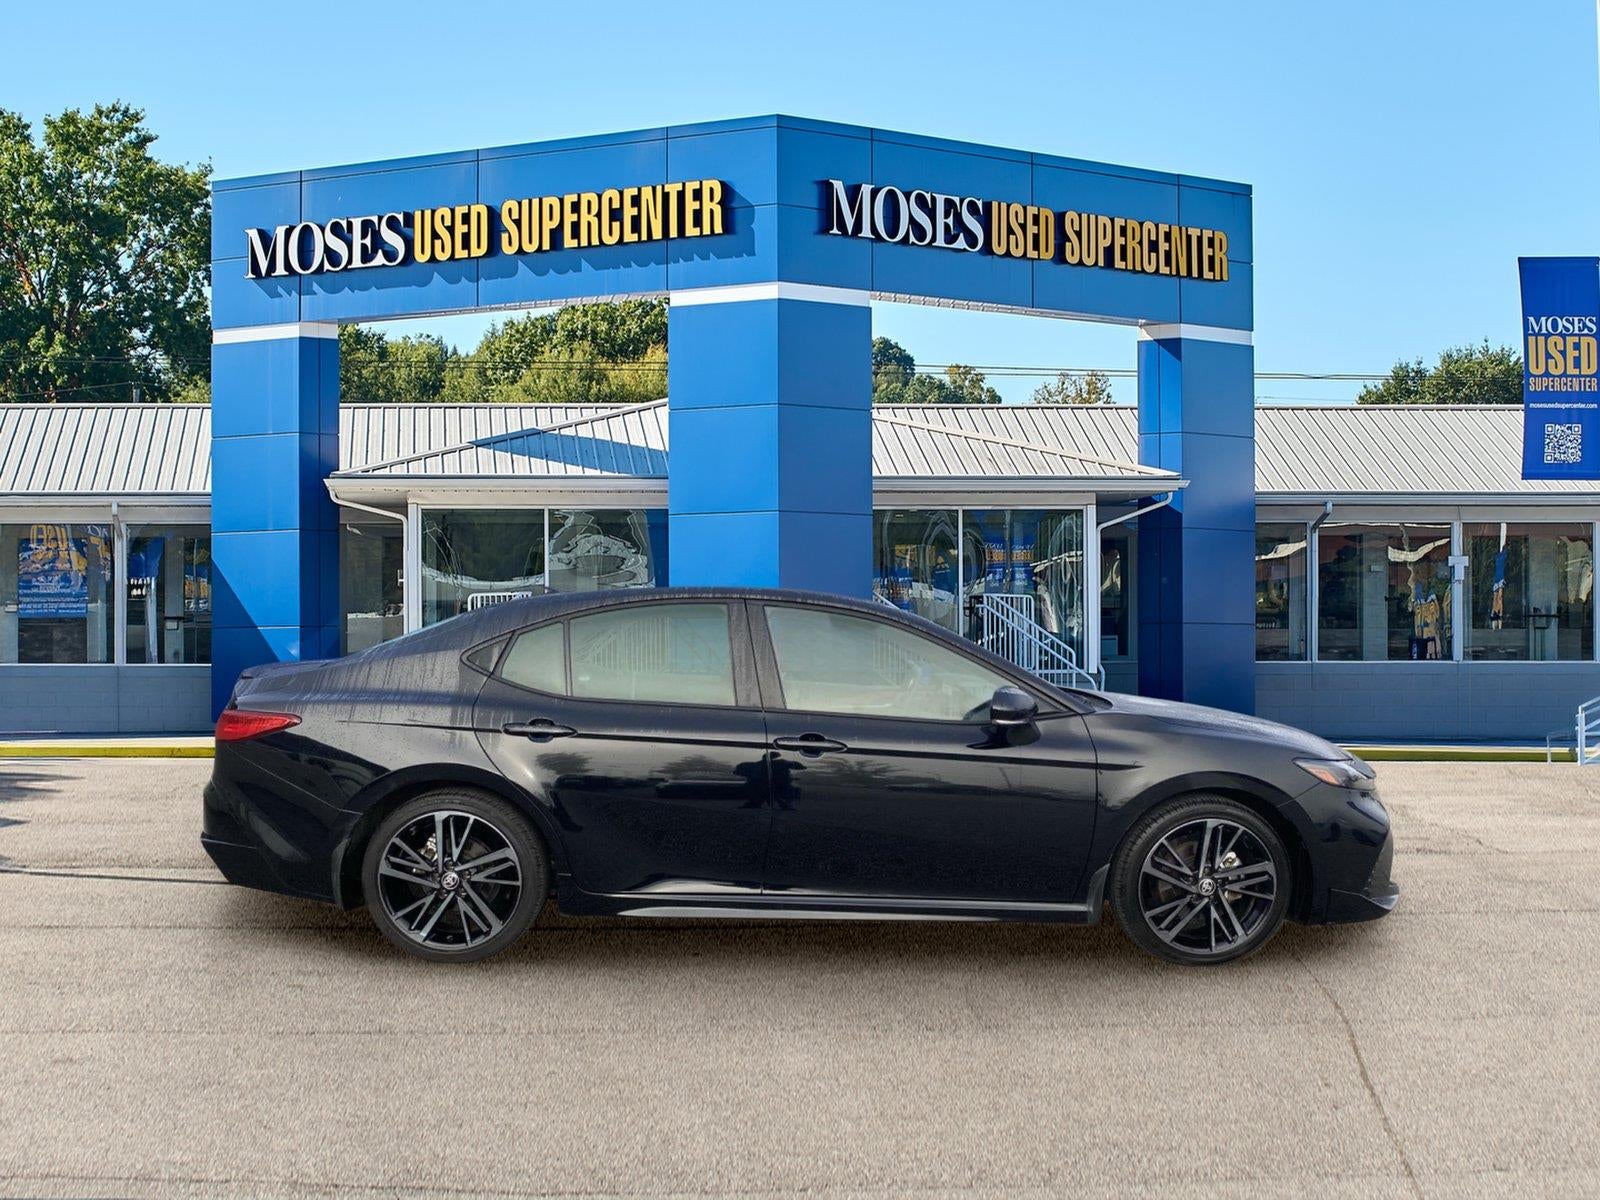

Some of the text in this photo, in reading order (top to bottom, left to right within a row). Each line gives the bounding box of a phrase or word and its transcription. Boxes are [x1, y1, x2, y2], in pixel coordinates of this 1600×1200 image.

[244, 179, 725, 280] MOSES USED SUPERCENTER
[828, 179, 1229, 282] MOSES USED SUPERCENTER
[1527, 316, 1597, 334] MOSES
[1528, 336, 1598, 375] USED
[1529, 377, 1598, 392] SUPERCENTER
